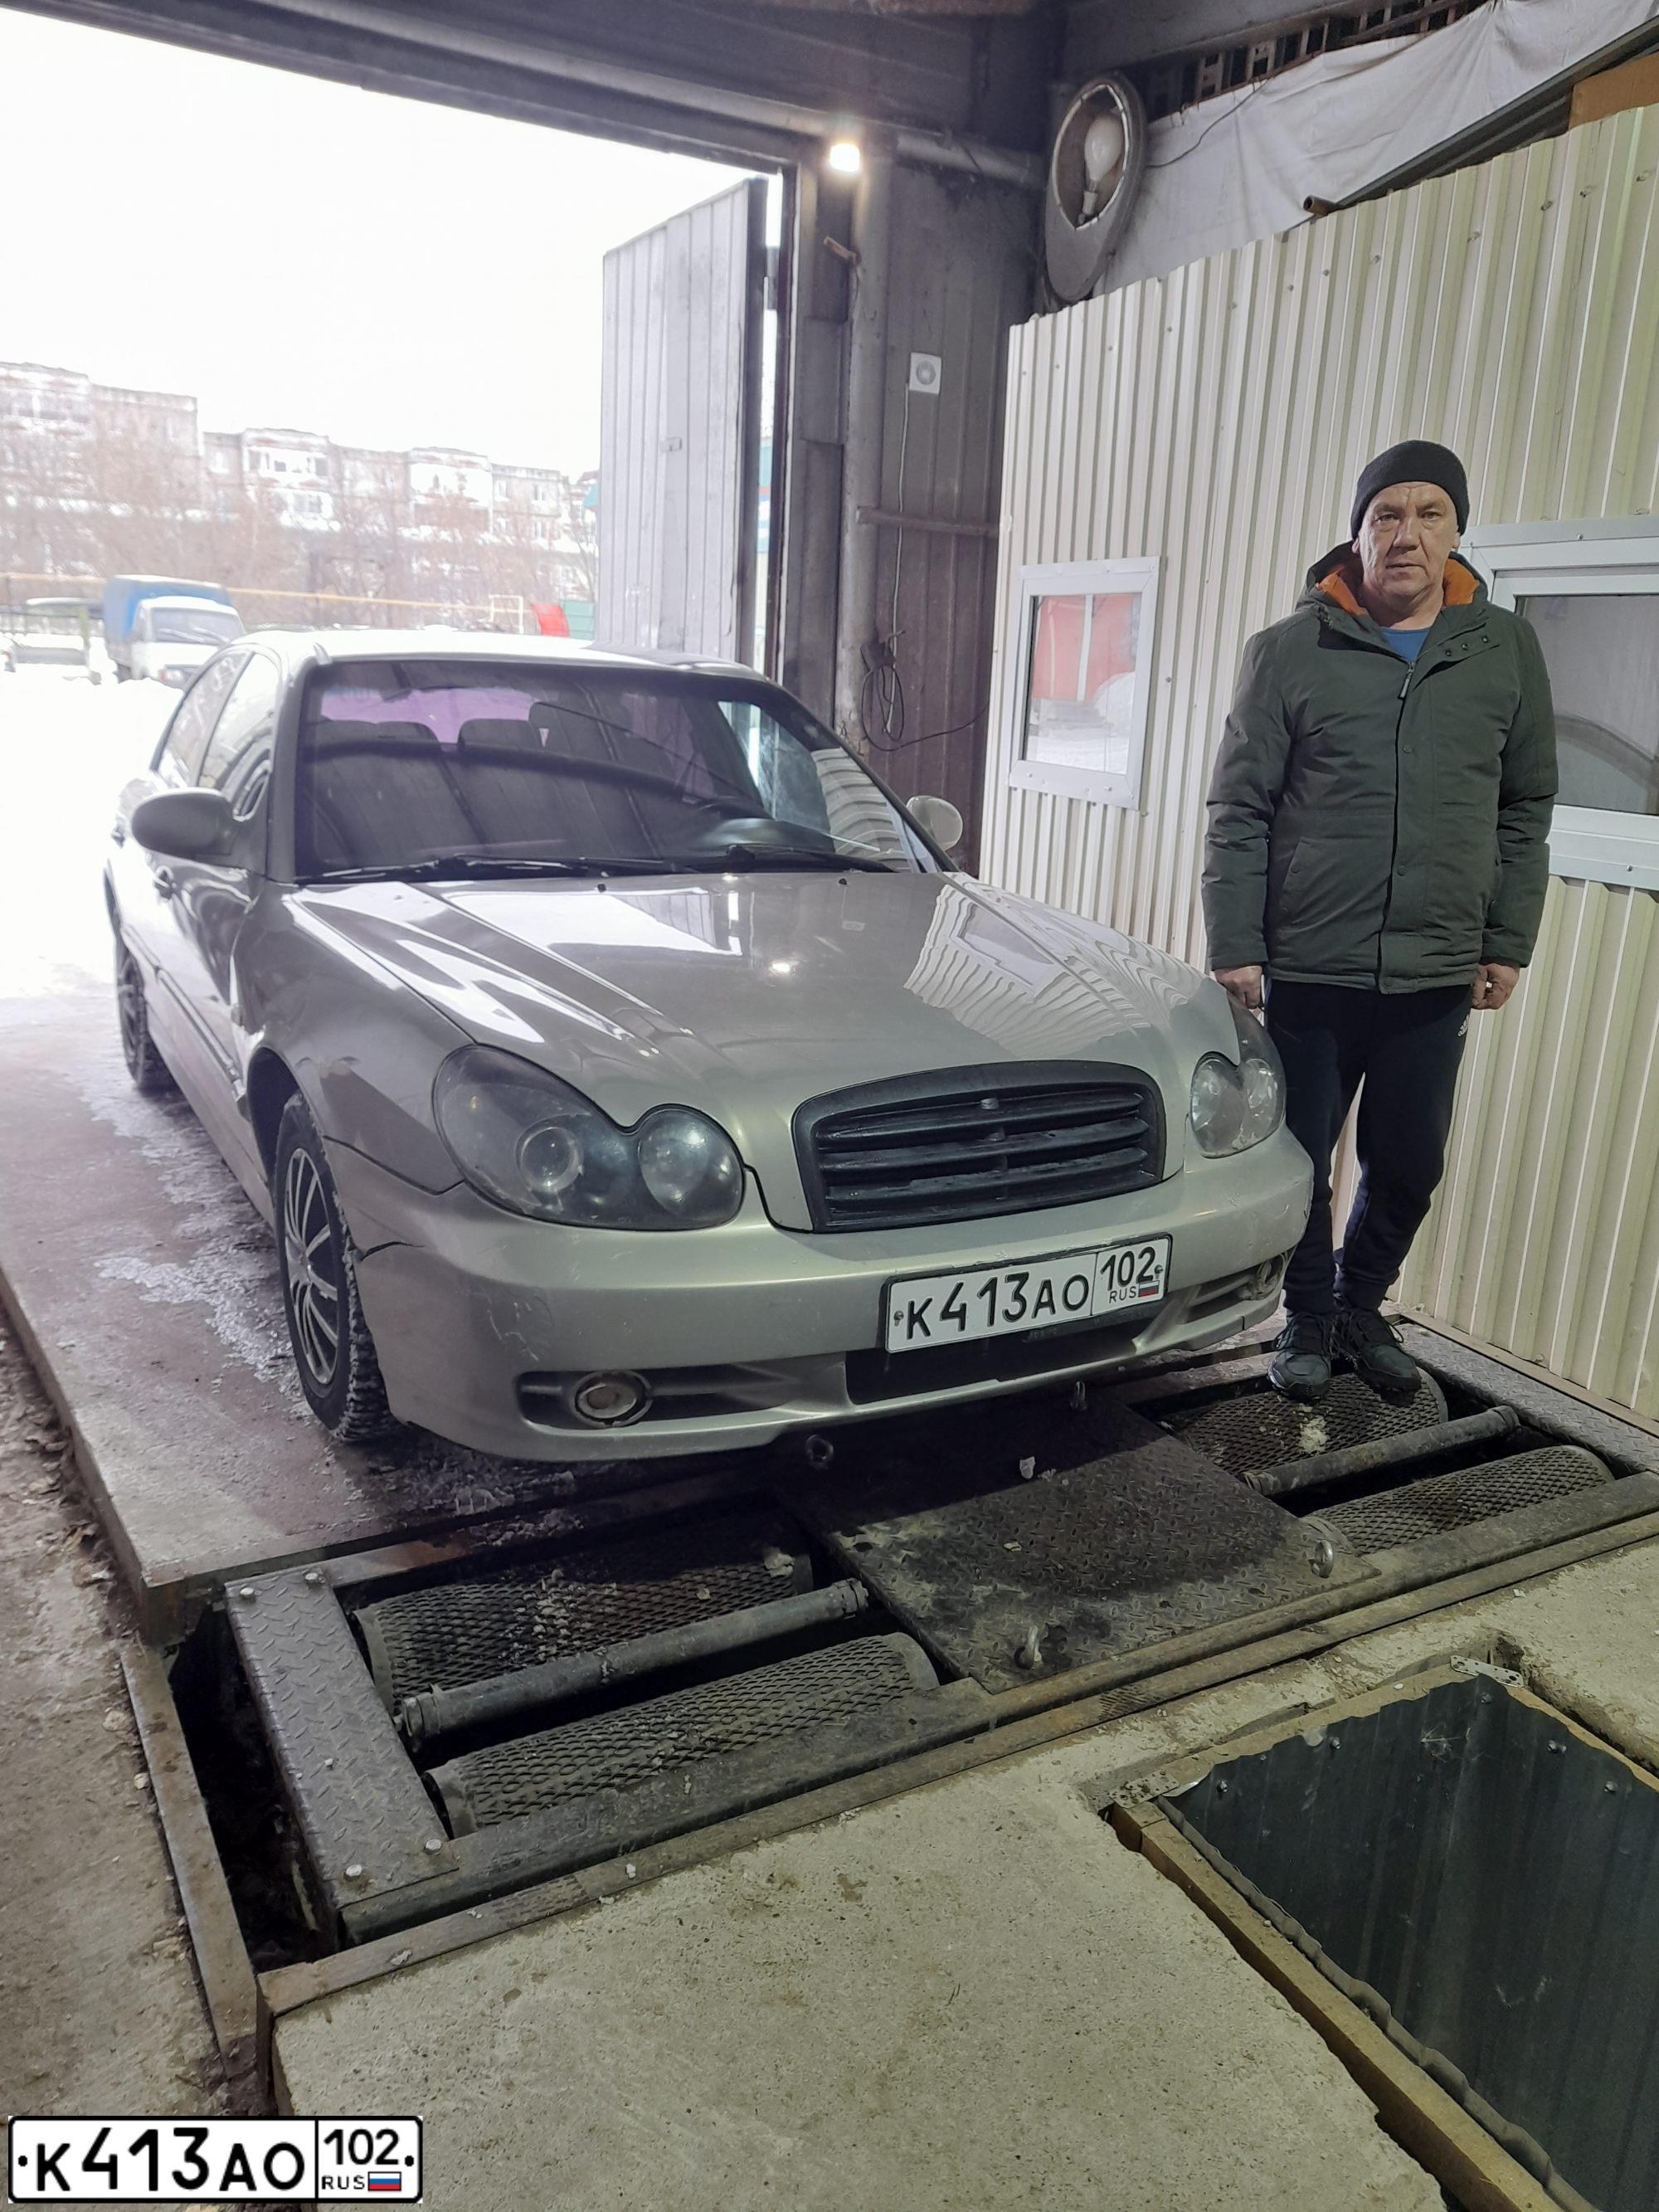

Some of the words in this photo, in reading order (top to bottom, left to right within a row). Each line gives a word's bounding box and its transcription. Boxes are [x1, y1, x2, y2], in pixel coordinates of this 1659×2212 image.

[907, 1271, 1089, 1340] К413АО
[1100, 1246, 1156, 1290] 102
[1108, 1287, 1136, 1304] RUS
